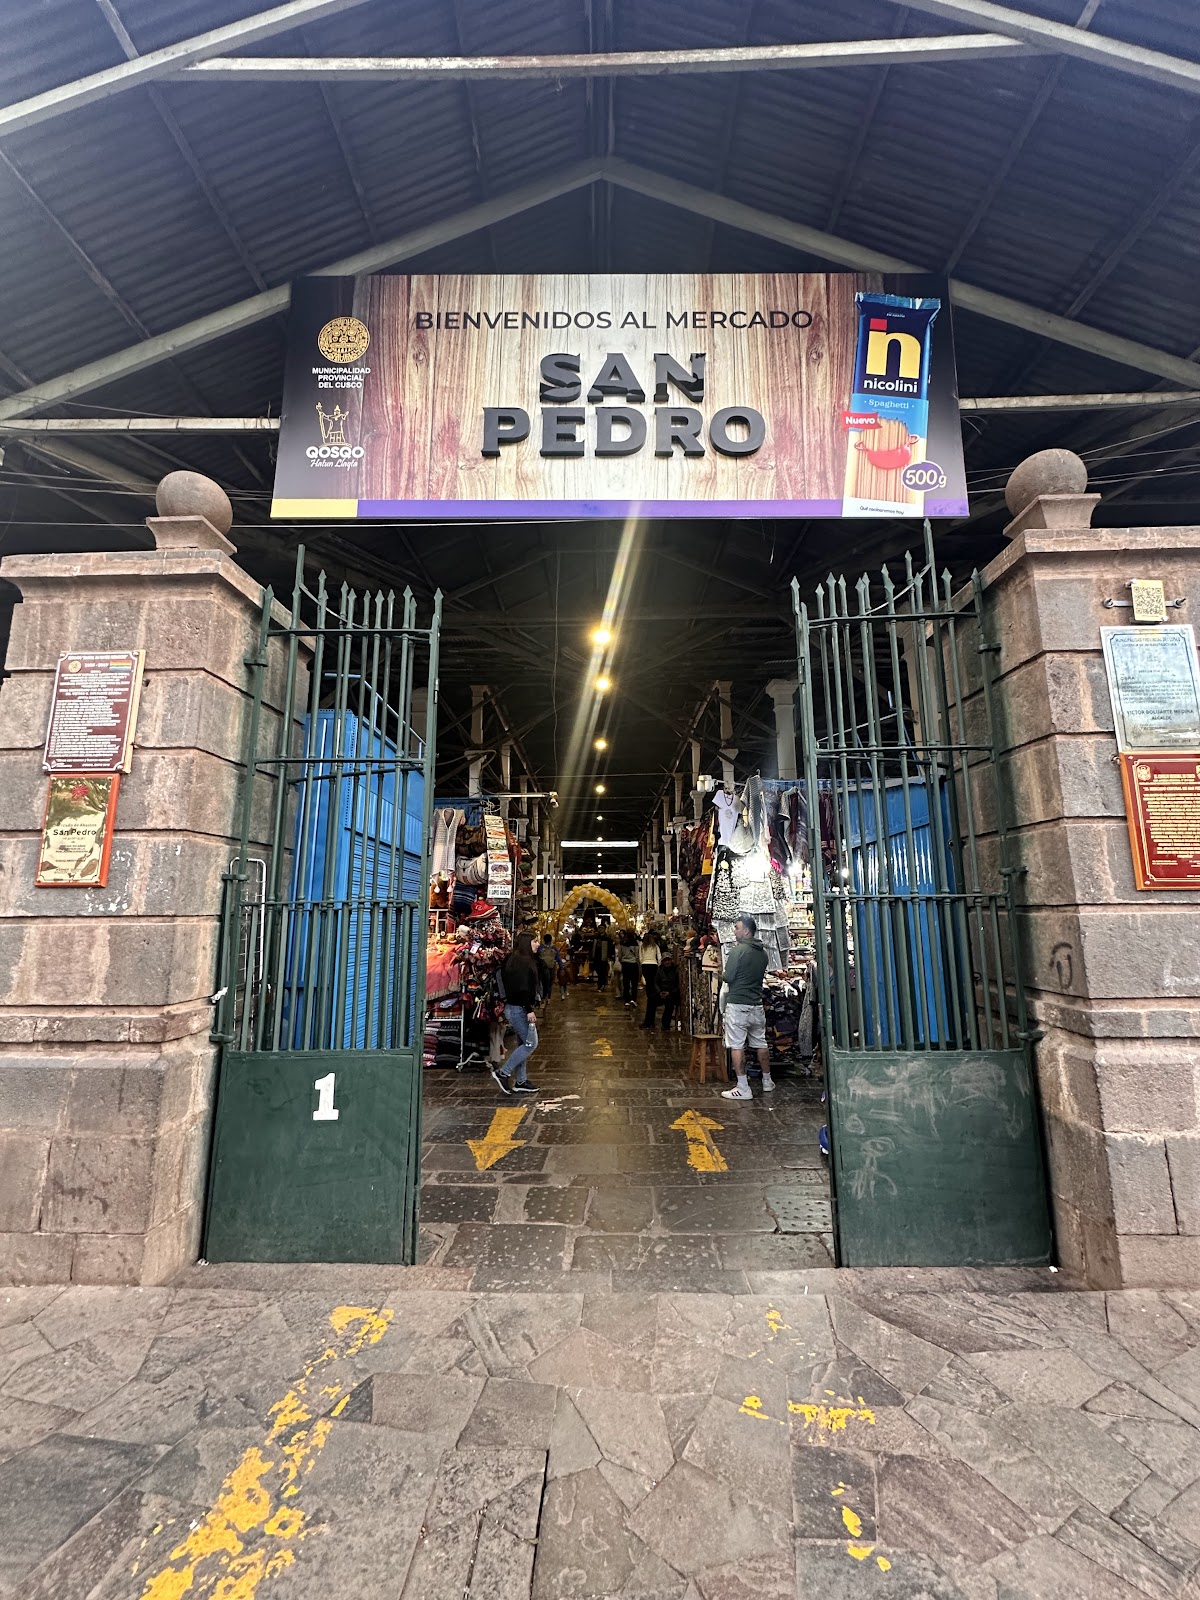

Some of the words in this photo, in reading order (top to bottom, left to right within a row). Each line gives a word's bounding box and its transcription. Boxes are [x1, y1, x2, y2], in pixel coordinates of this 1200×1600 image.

[415, 311, 612, 330] BIENVENIDOS
[620, 311, 657, 329] AL
[666, 310, 813, 329] MERCADO
[312, 367, 371, 375] MUNICIPALIDAD
[318, 374, 364, 382] PROVINCIAL
[539, 352, 707, 403] SAN
[863, 378, 918, 393] nicolini
[868, 399, 909, 409] Spaghetti
[845, 416, 876, 425] Nuevo
[481, 406, 766, 457] PEDRO
[306, 446, 365, 461] QOSQO
[310, 458, 333, 468] Hatun
[334, 457, 359, 471] Llaqta
[905, 469, 947, 489] 500g
[53, 828, 69, 836] San
[70, 828, 97, 836] Pedro
[313, 1072, 340, 1121] 1
